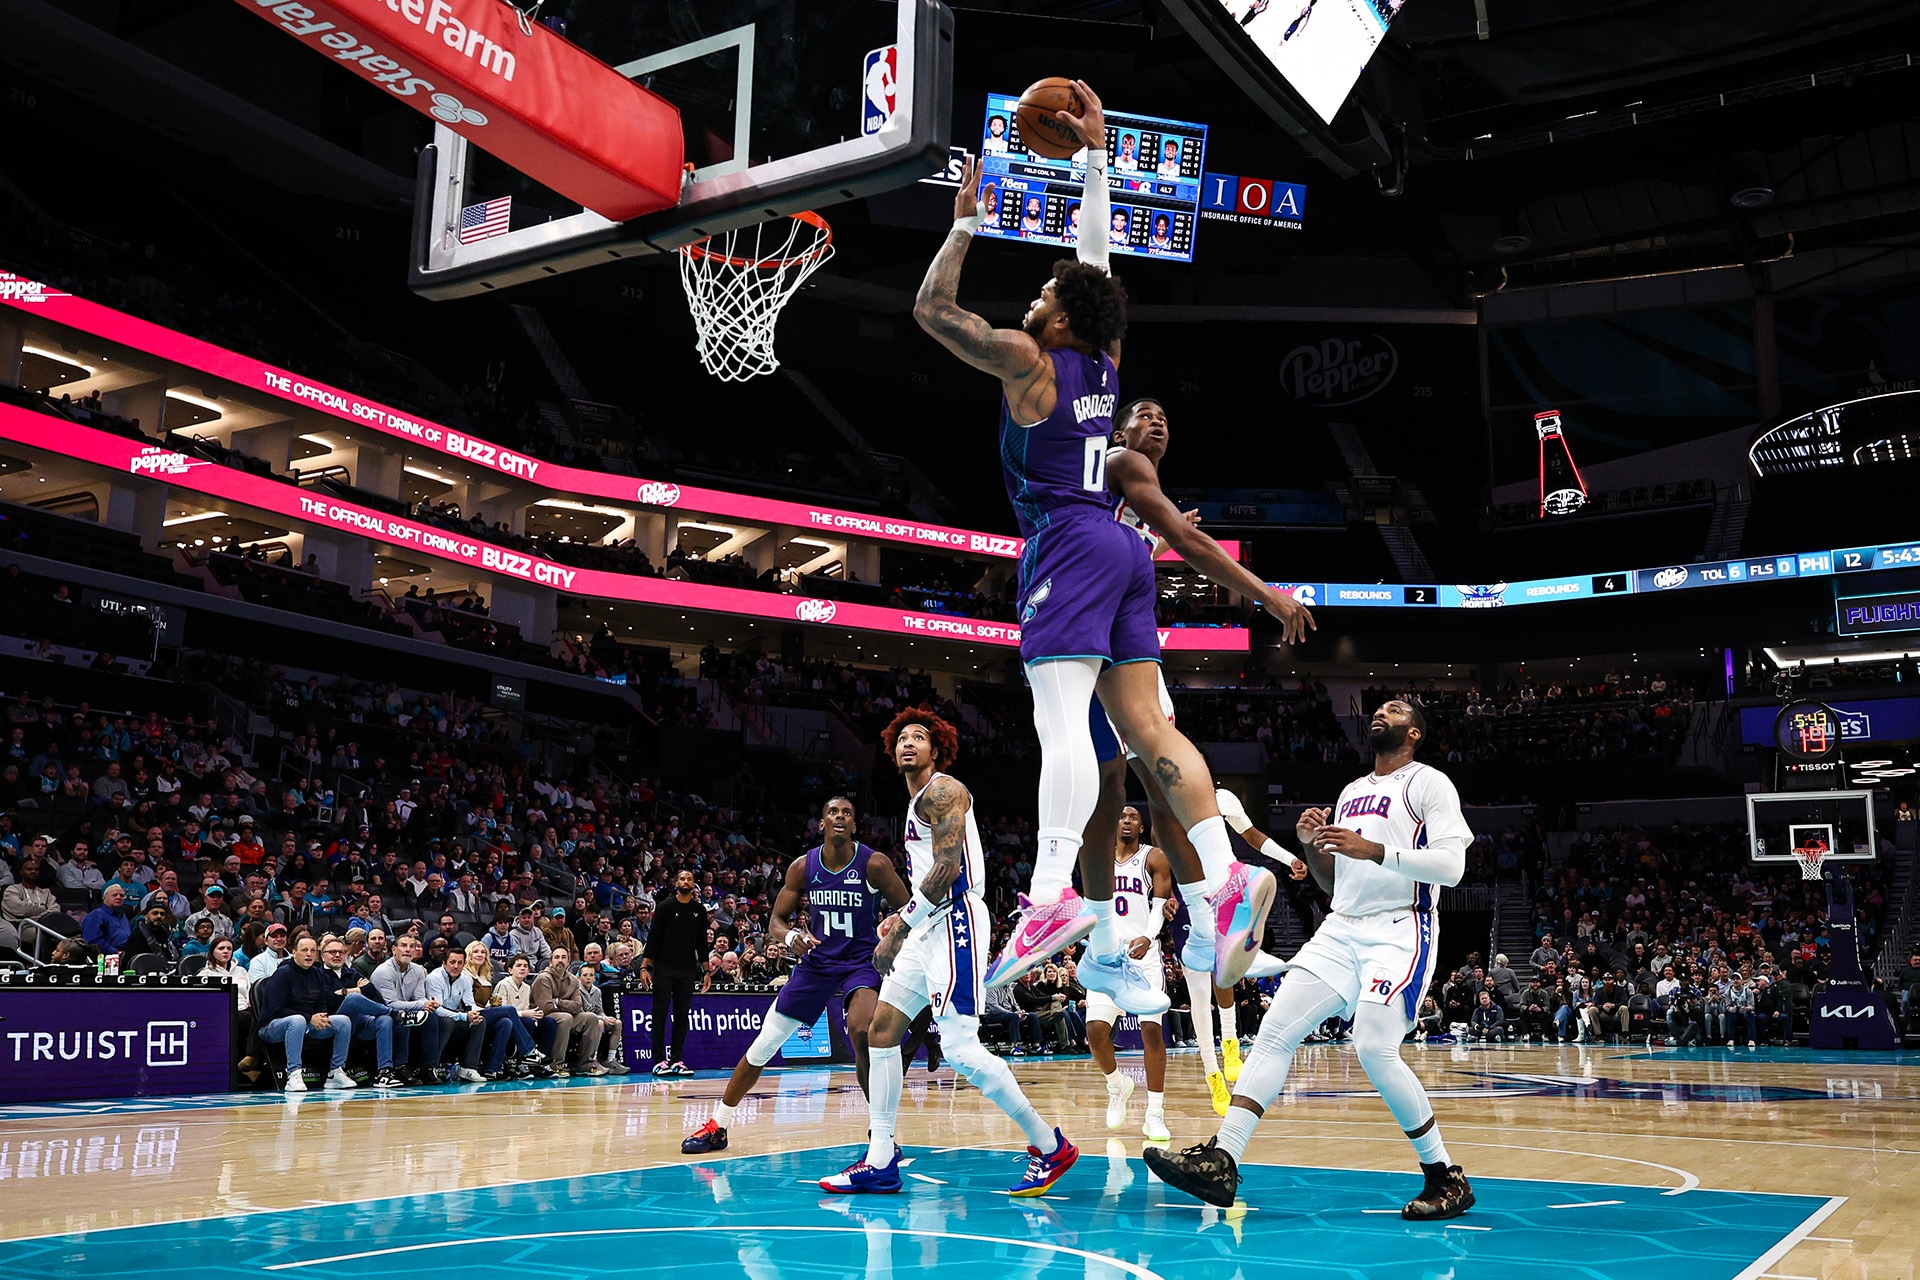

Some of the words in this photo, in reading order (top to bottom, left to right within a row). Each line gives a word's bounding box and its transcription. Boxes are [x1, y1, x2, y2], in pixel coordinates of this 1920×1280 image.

[256, 0, 435, 96] StateFa
[377, 0, 516, 82] teFarm
[867, 115, 883, 132] NBA
[1001, 177, 1028, 190] 76ers
[1201, 211, 1237, 222] INSURANCE
[1240, 216, 1262, 225] OFFICE
[1273, 220, 1302, 230] AMERICA
[1027, 232, 1062, 243] Drummond
[0, 281, 47, 299] epper
[1320, 338, 1362, 370] Dr
[1294, 345, 1390, 399] Pepper
[1412, 386, 1433, 398] 215
[1857, 378, 1917, 398] SKYLINE
[264, 371, 290, 393] THE
[293, 382, 350, 413] OFFICIAL
[351, 402, 385, 425] SOFT
[387, 415, 424, 438] DRINK
[425, 428, 442, 443] OF
[446, 433, 497, 466] BUZZ
[499, 452, 539, 479] CITY
[130, 453, 188, 473] pepper
[1083, 436, 1108, 492] 0
[300, 496, 327, 517] THE
[329, 506, 385, 534] OFFICIAL
[387, 522, 422, 543] SOFT
[423, 534, 460, 555] DRINK
[461, 543, 478, 558] OF
[481, 547, 531, 578] BUZZ
[534, 562, 576, 589] CITY
[809, 511, 832, 525] THE
[834, 515, 883, 534] OFFICIAL
[884, 523, 915, 538] SOFT
[916, 528, 949, 543] DRINK
[950, 534, 966, 545] OF
[970, 534, 1017, 556] BUZZ
[1700, 569, 1727, 581] TOL
[1729, 565, 1741, 578] 6
[1750, 564, 1774, 576] FLS
[1779, 561, 1790, 574] 0
[1799, 556, 1829, 572] PHI
[1843, 554, 1862, 568] 12
[1339, 590, 1392, 601] REBOUNDS
[1416, 590, 1425, 602] 2
[1526, 583, 1580, 597] REBOUNDS
[1604, 578, 1614, 590] 4
[903, 616, 926, 630] THE
[927, 619, 975, 636] OFFICIAL
[977, 625, 1006, 640] SOFT
[1795, 713, 1827, 728] 5:43
[1800, 728, 1826, 752] 19
[1798, 763, 1835, 771] TISSOT
[1338, 794, 1391, 824] PHILA
[1113, 876, 1143, 896] ILA
[809, 890, 863, 907] HORNETS
[1115, 896, 1128, 916] 0
[819, 910, 853, 938] 14
[1, 975, 10, 983] G
[26, 975, 34, 983] G
[49, 975, 57, 983] G
[72, 975, 80, 983] G
[94, 976, 102, 984] G
[117, 976, 125, 984] G
[221, 976, 228, 984] G
[1370, 978, 1392, 995] 76
[632, 1009, 652, 1032] Pa
[1821, 1005, 1874, 1018] KIA
[1119, 1017, 1142, 1031] TRUIS
[6, 1030, 138, 1062] TRUIST
[634, 1049, 652, 1060] TRU
